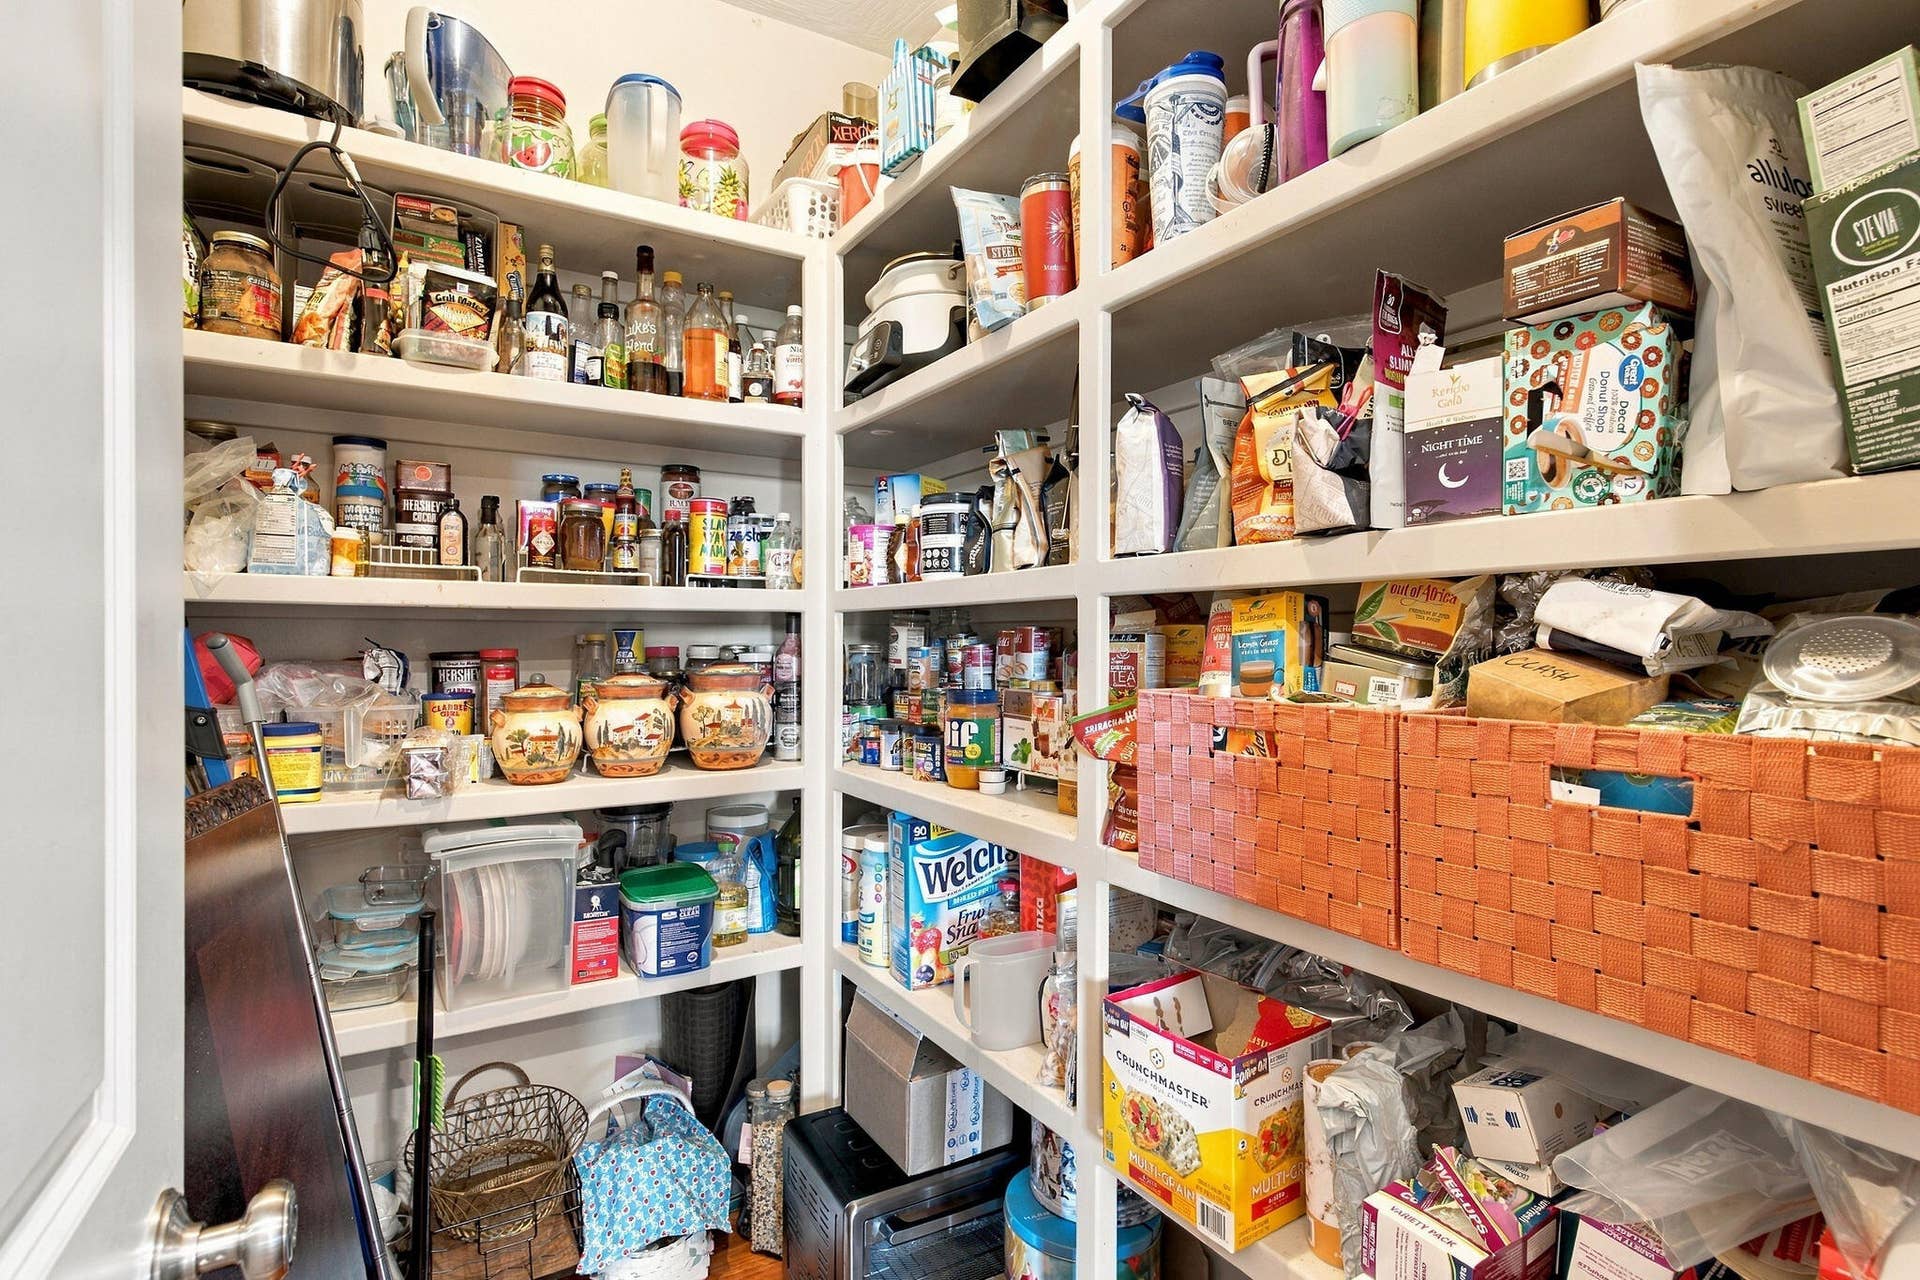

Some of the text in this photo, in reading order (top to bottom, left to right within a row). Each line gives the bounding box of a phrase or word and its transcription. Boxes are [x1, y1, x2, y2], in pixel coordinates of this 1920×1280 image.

[1746, 158, 1814, 198] allulos
[1852, 207, 1899, 248] STEVIA
[992, 246, 1018, 258] STEEL
[1831, 265, 1901, 296] Nutrition
[435, 293, 486, 313] Grill Mates
[1838, 305, 1884, 325] Calories
[625, 320, 657, 337] Luke's
[1629, 358, 1639, 386] Great
[1595, 371, 1610, 434] Donut Shop
[1617, 401, 1630, 435] Decaf
[1421, 434, 1484, 454] NIGHT TIME
[1624, 475, 1637, 490] 12
[1390, 583, 1458, 605] out of Africa
[617, 650, 633, 658] SEA
[1216, 642, 1230, 650] TEA
[1238, 638, 1279, 649] Lemon Grass
[1110, 671, 1136, 684] TEA
[945, 720, 979, 747] Jif
[913, 826, 927, 836] 90
[919, 843, 1018, 895] Welchs
[946, 923, 979, 945] Sna
[949, 950, 959, 961] NO
[1115, 1050, 1209, 1108] CRUNCHMASTER
[1254, 1080, 1304, 1106] CRUNCHMAS
[1128, 1151, 1196, 1201] MULTI-GRAIN
[1251, 1161, 1305, 1197] MULTI-GR
[1390, 1205, 1457, 1249] VARIETY PACK
